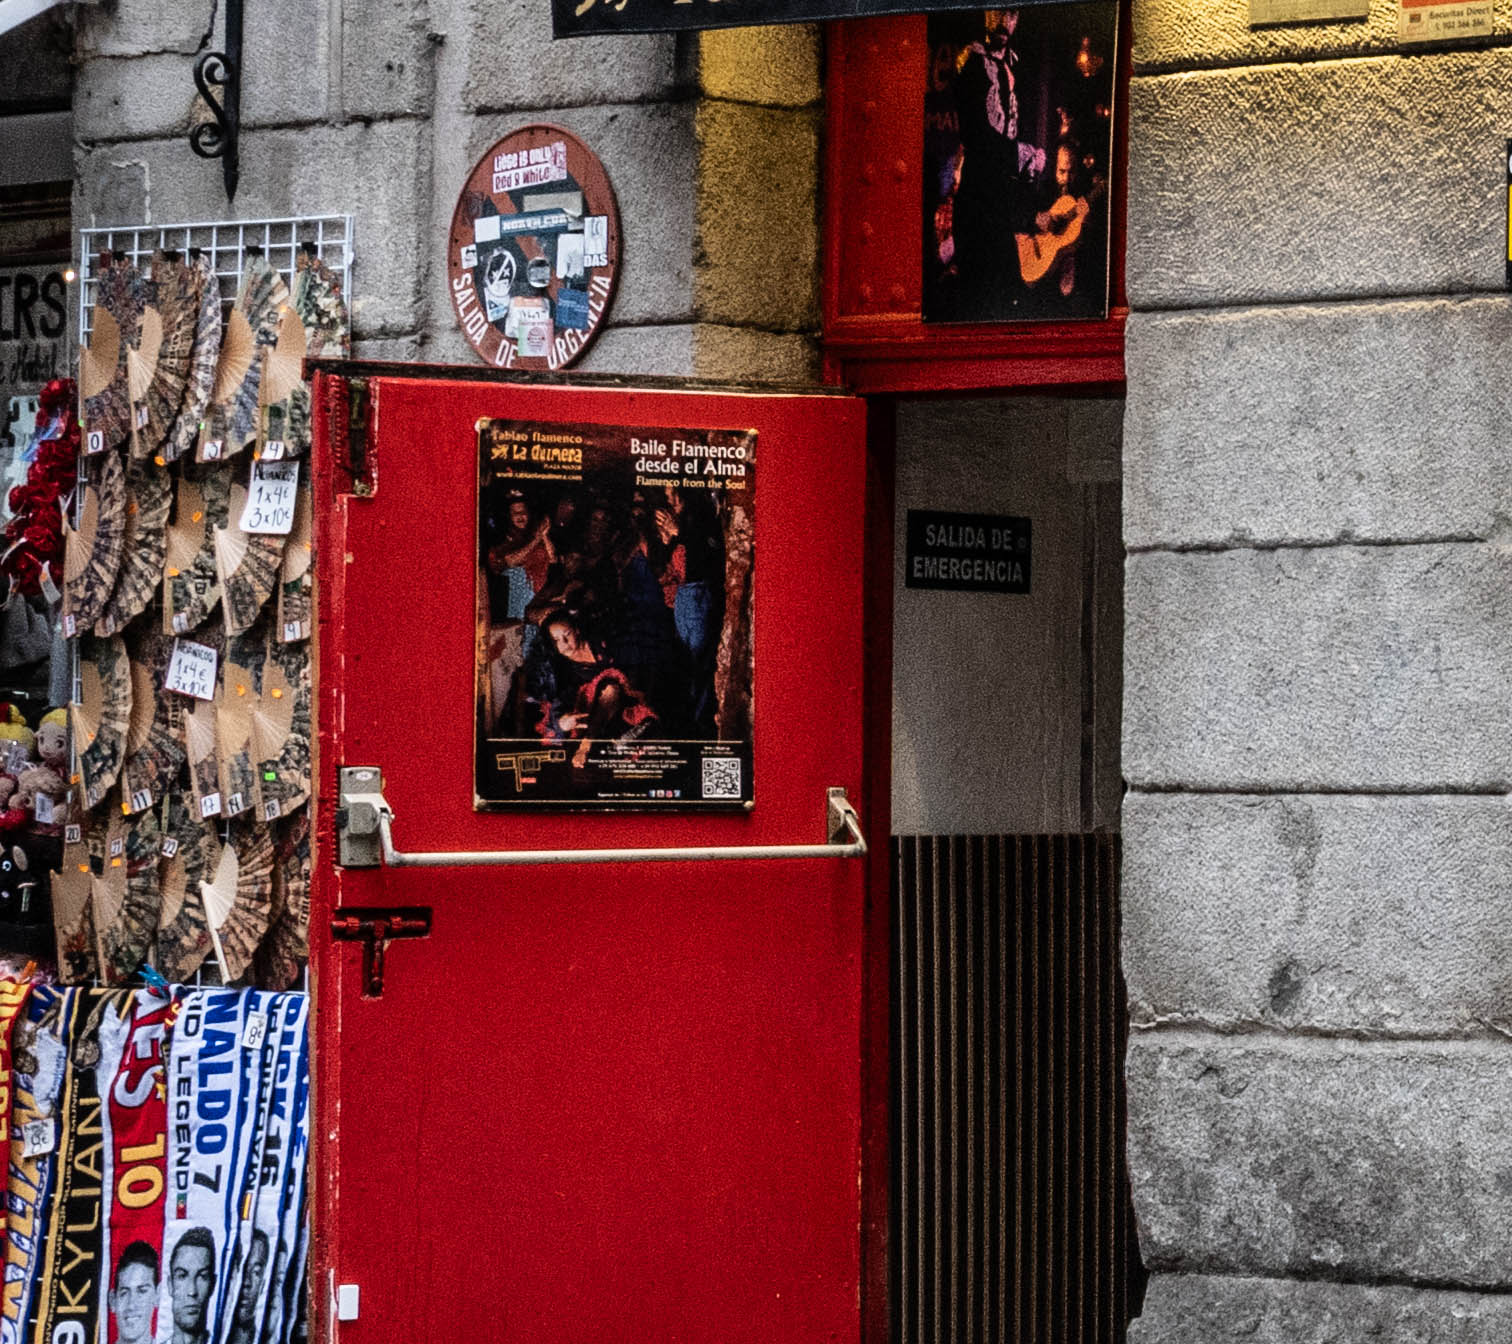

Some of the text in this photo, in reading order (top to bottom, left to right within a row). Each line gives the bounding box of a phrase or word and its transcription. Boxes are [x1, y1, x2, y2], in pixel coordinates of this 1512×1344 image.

[452, 272, 490, 346] SALIDA
[495, 343, 520, 369] DE
[491, 430, 583, 444] Tablao flamenco
[630, 437, 746, 459] Baile Flamenco
[635, 456, 746, 477] desde el Alma
[635, 475, 747, 490] Flamenco from the Soul
[925, 523, 1013, 551] SALIDA DE
[912, 556, 1024, 584] EMERGENCIA
[174, 1055, 193, 1192] LEGEND
[117, 1132, 166, 1208] 10
[56, 1097, 103, 1315] KYLIAN
